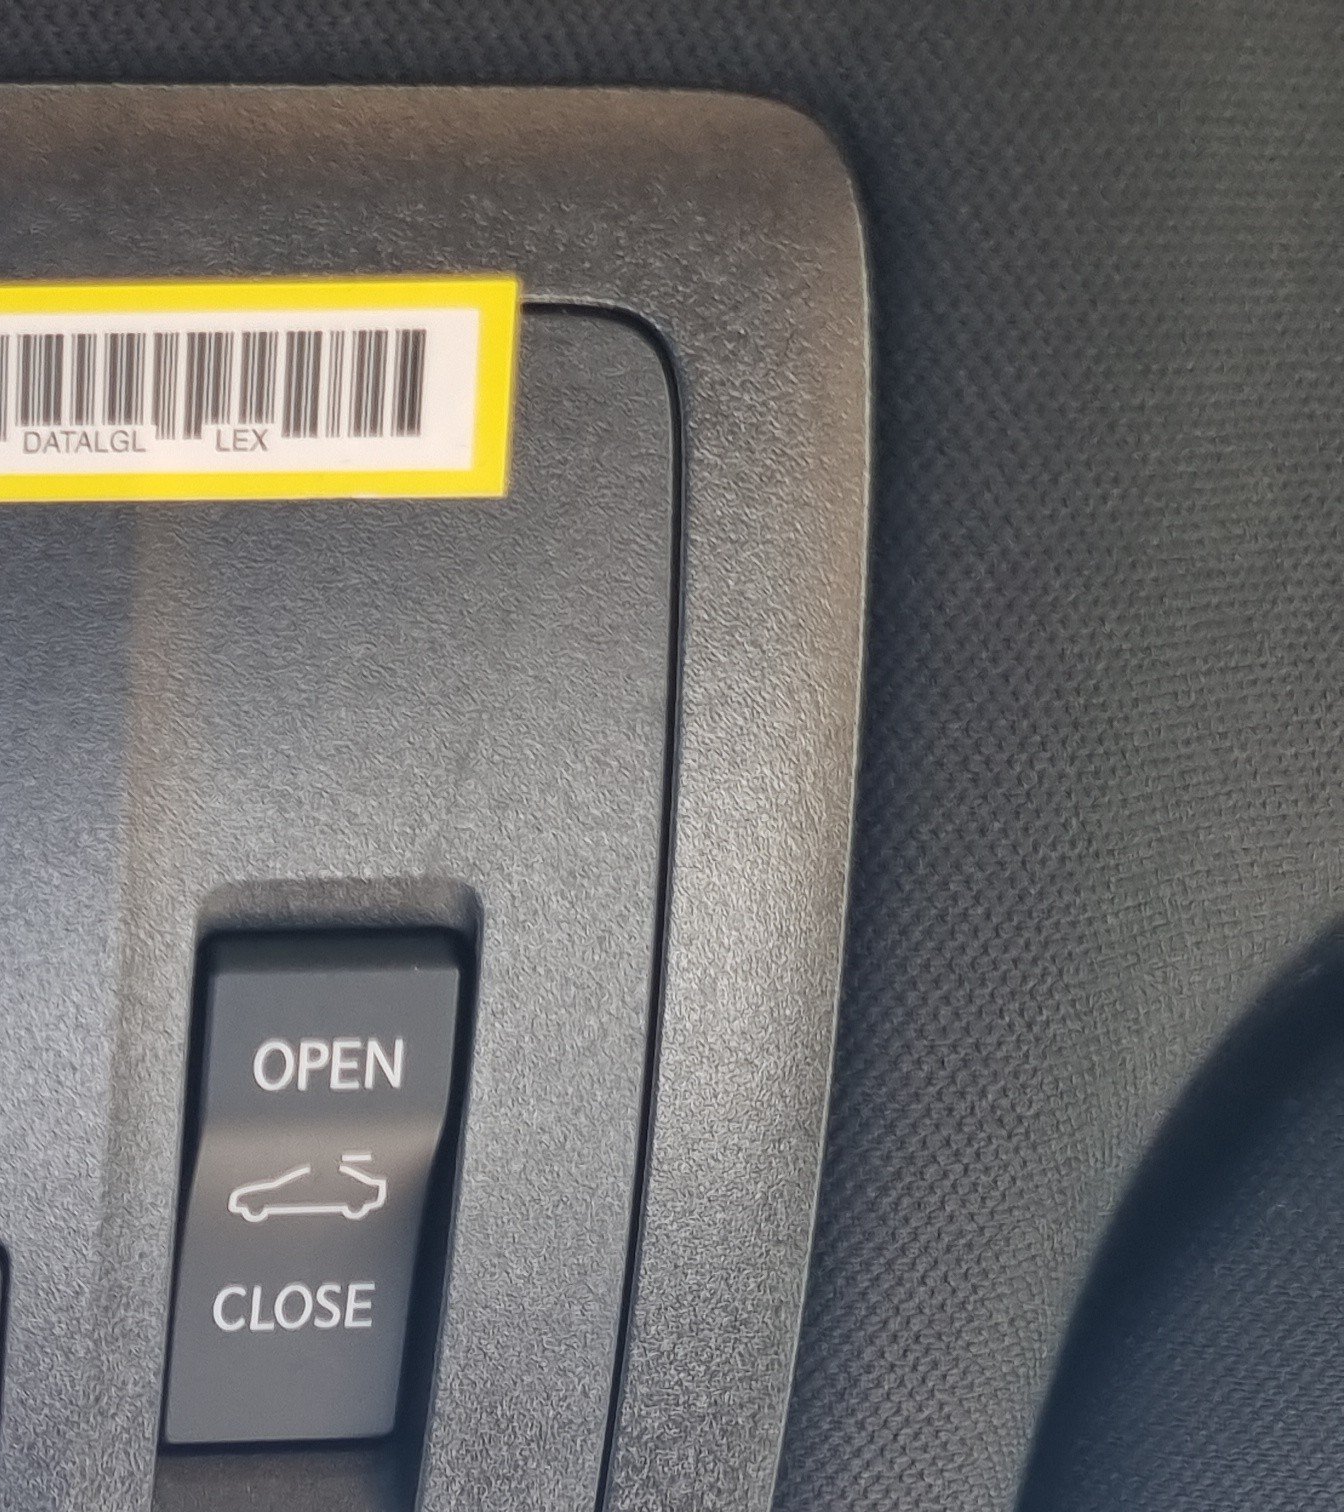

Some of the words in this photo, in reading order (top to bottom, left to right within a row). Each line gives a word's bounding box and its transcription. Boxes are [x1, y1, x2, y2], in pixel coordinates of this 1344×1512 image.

[23, 427, 146, 455] DATALGL
[216, 427, 268, 453] LEX
[253, 1037, 404, 1091] OPEN
[213, 1281, 376, 1332] CLOSE
